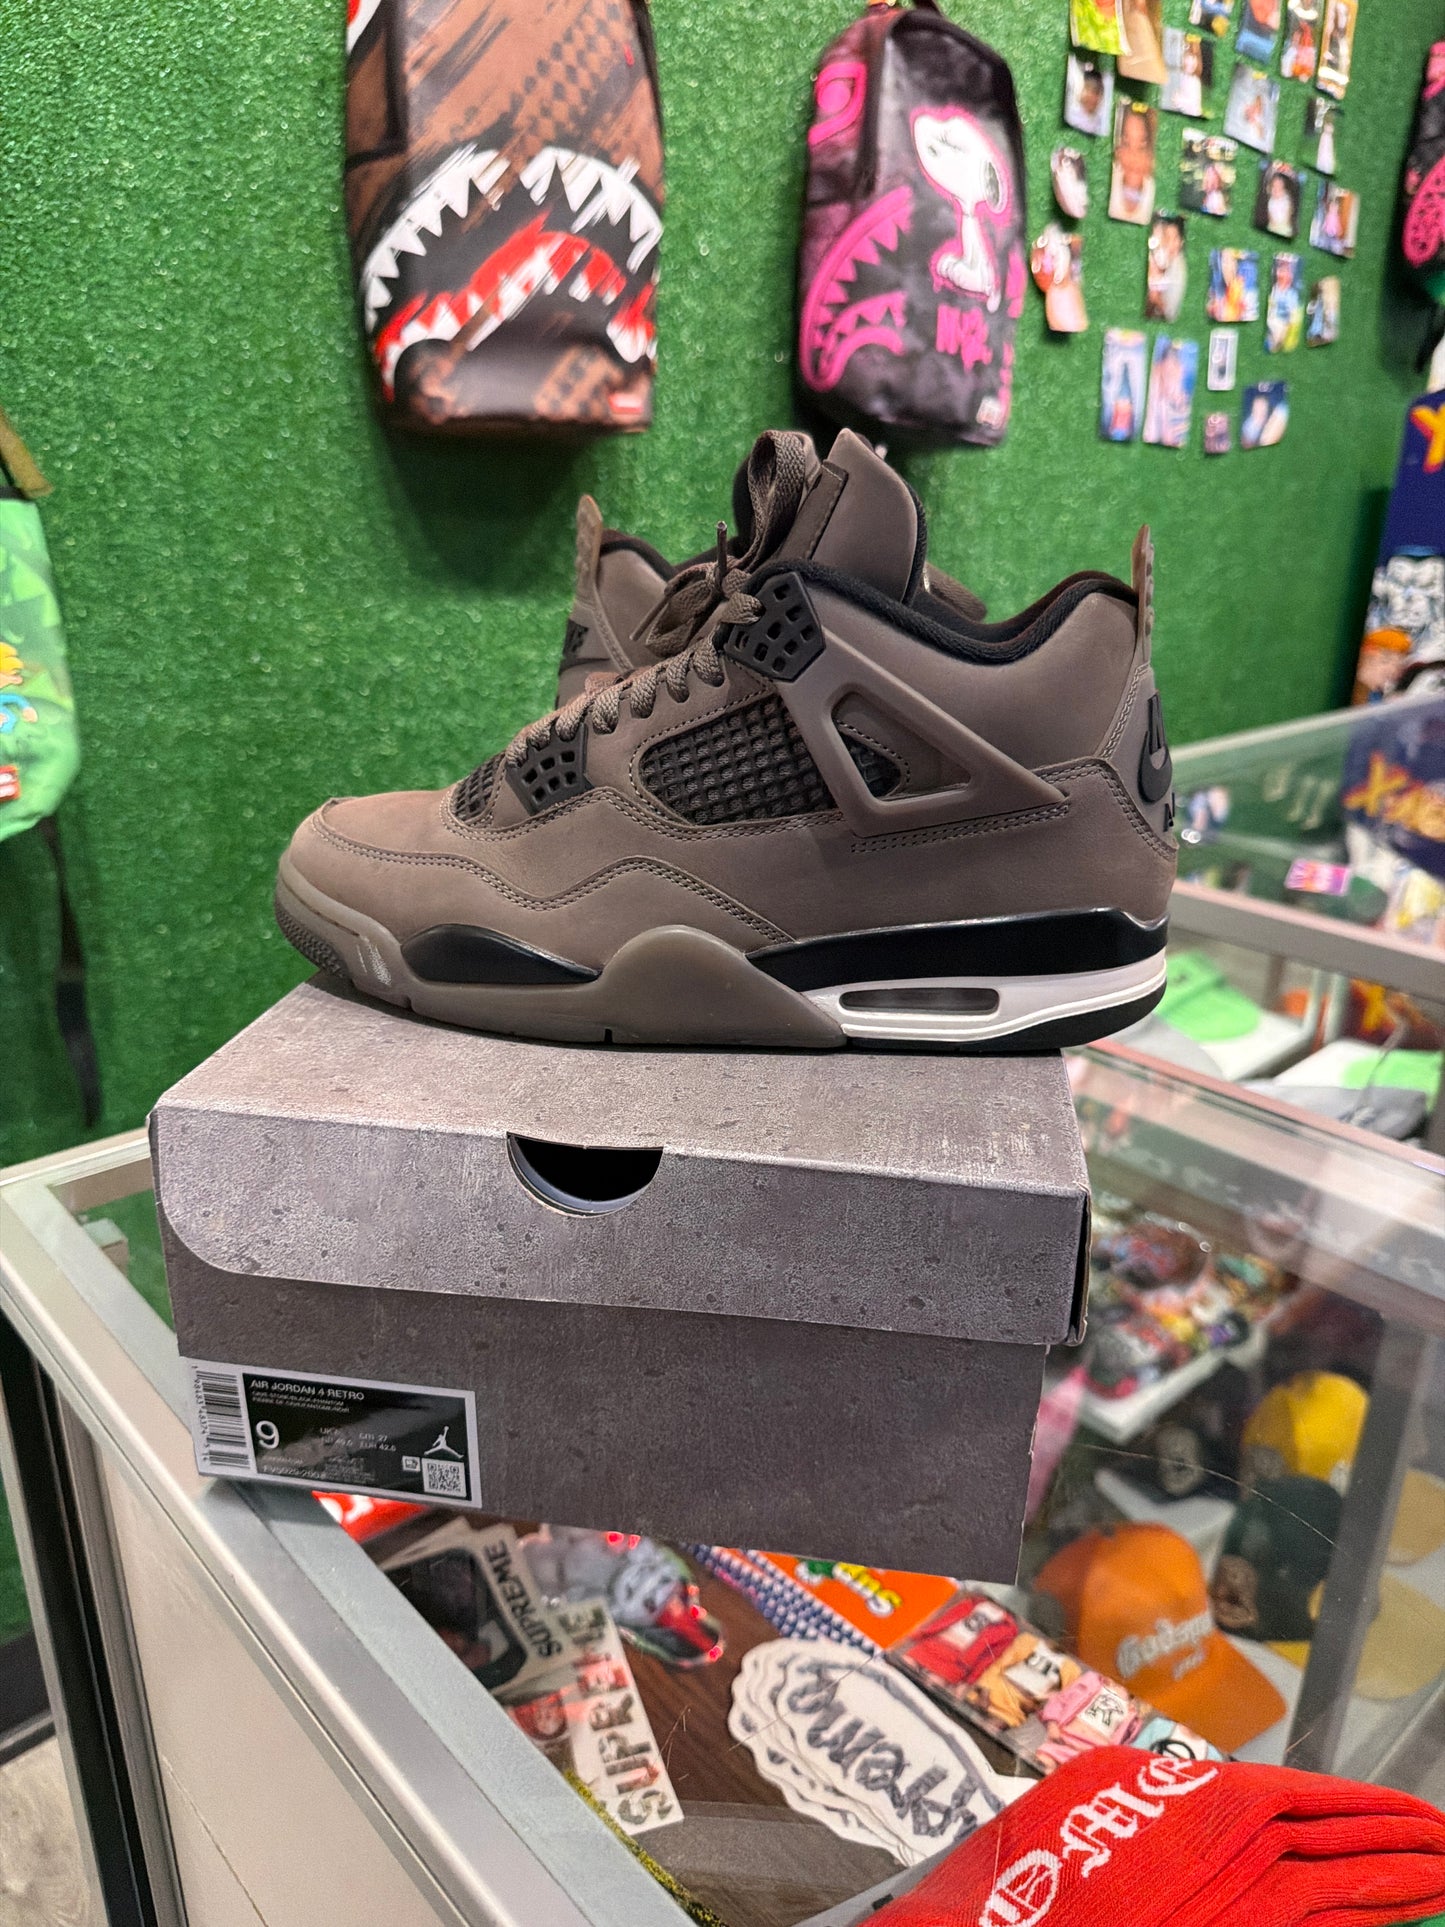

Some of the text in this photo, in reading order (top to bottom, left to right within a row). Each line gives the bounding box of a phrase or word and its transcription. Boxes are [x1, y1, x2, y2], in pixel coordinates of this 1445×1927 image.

[250, 1379, 365, 1401] AIR JORDAN 4 RETRO
[256, 1420, 280, 1449] 9
